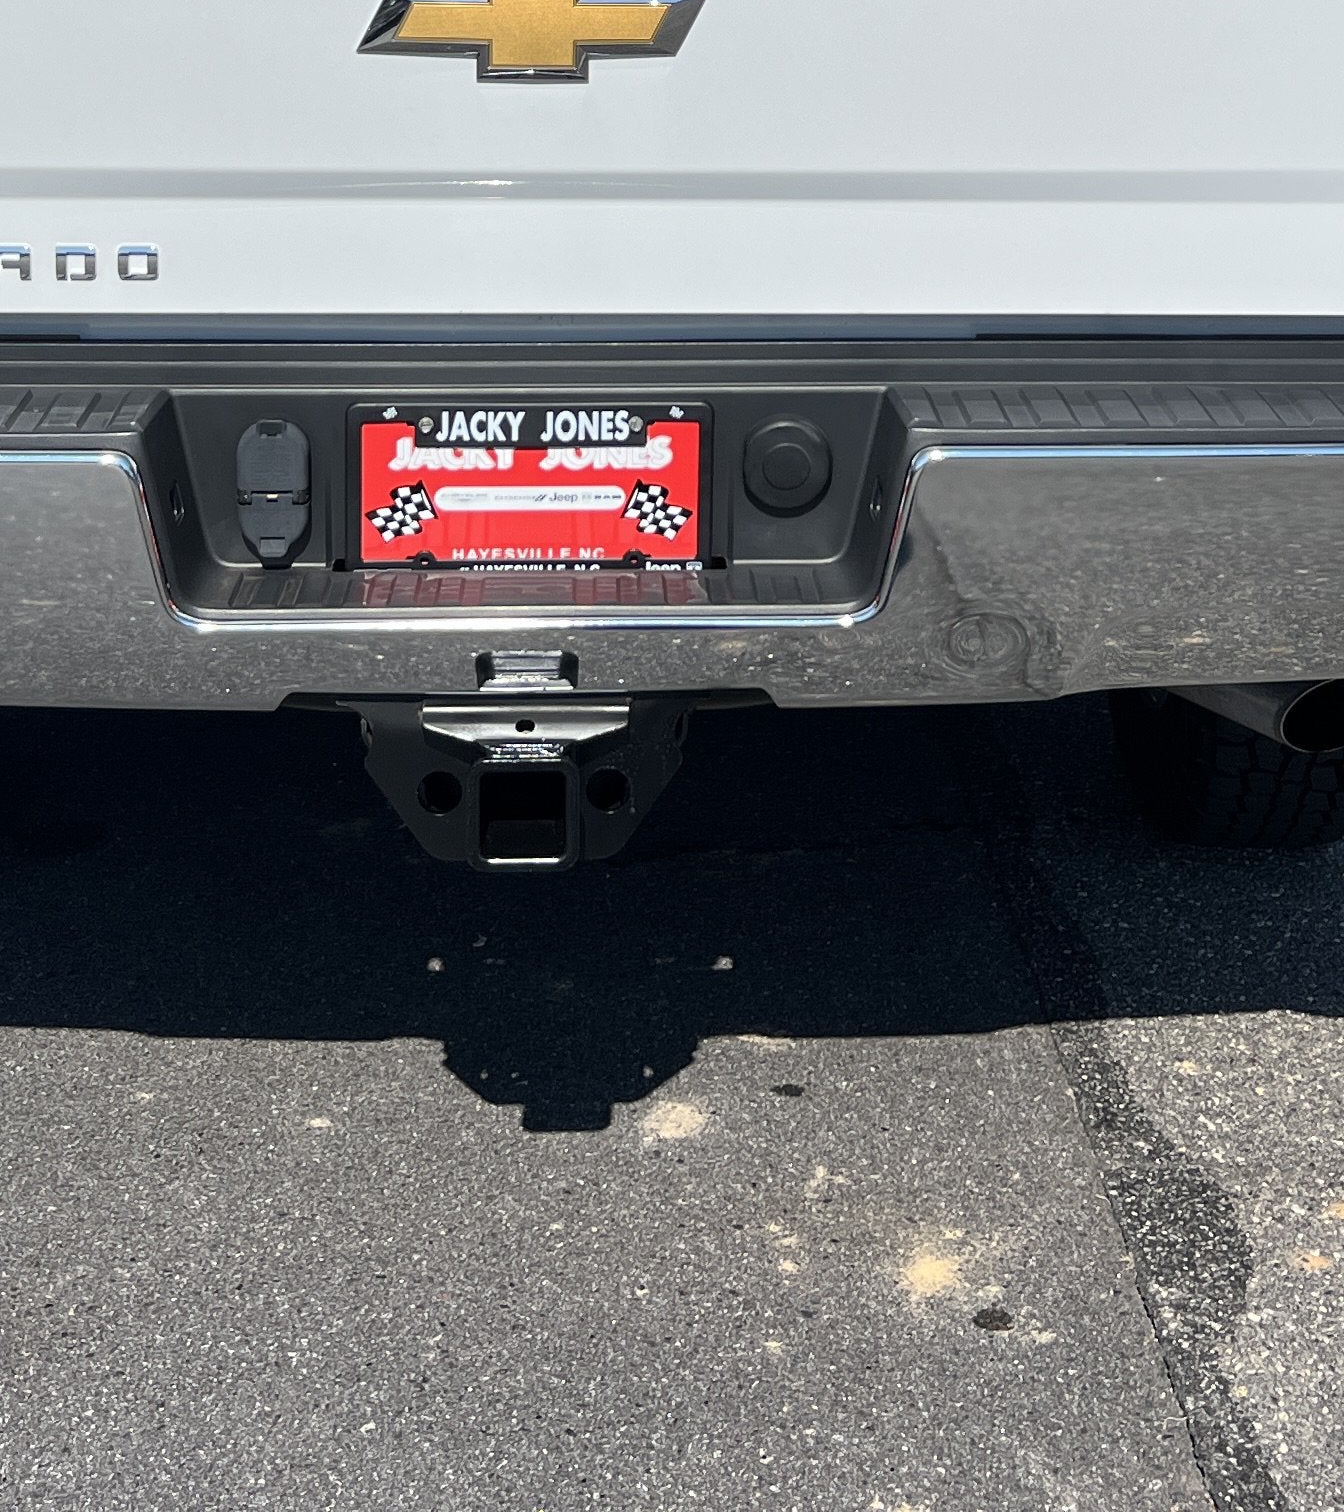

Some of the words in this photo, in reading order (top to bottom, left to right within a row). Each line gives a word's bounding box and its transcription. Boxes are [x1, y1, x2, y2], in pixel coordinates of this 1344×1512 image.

[435, 410, 526, 443] JACKY
[540, 409, 630, 443] JONES
[387, 436, 515, 471] JACKY
[539, 435, 674, 471] JONES
[549, 492, 578, 504] Jeep
